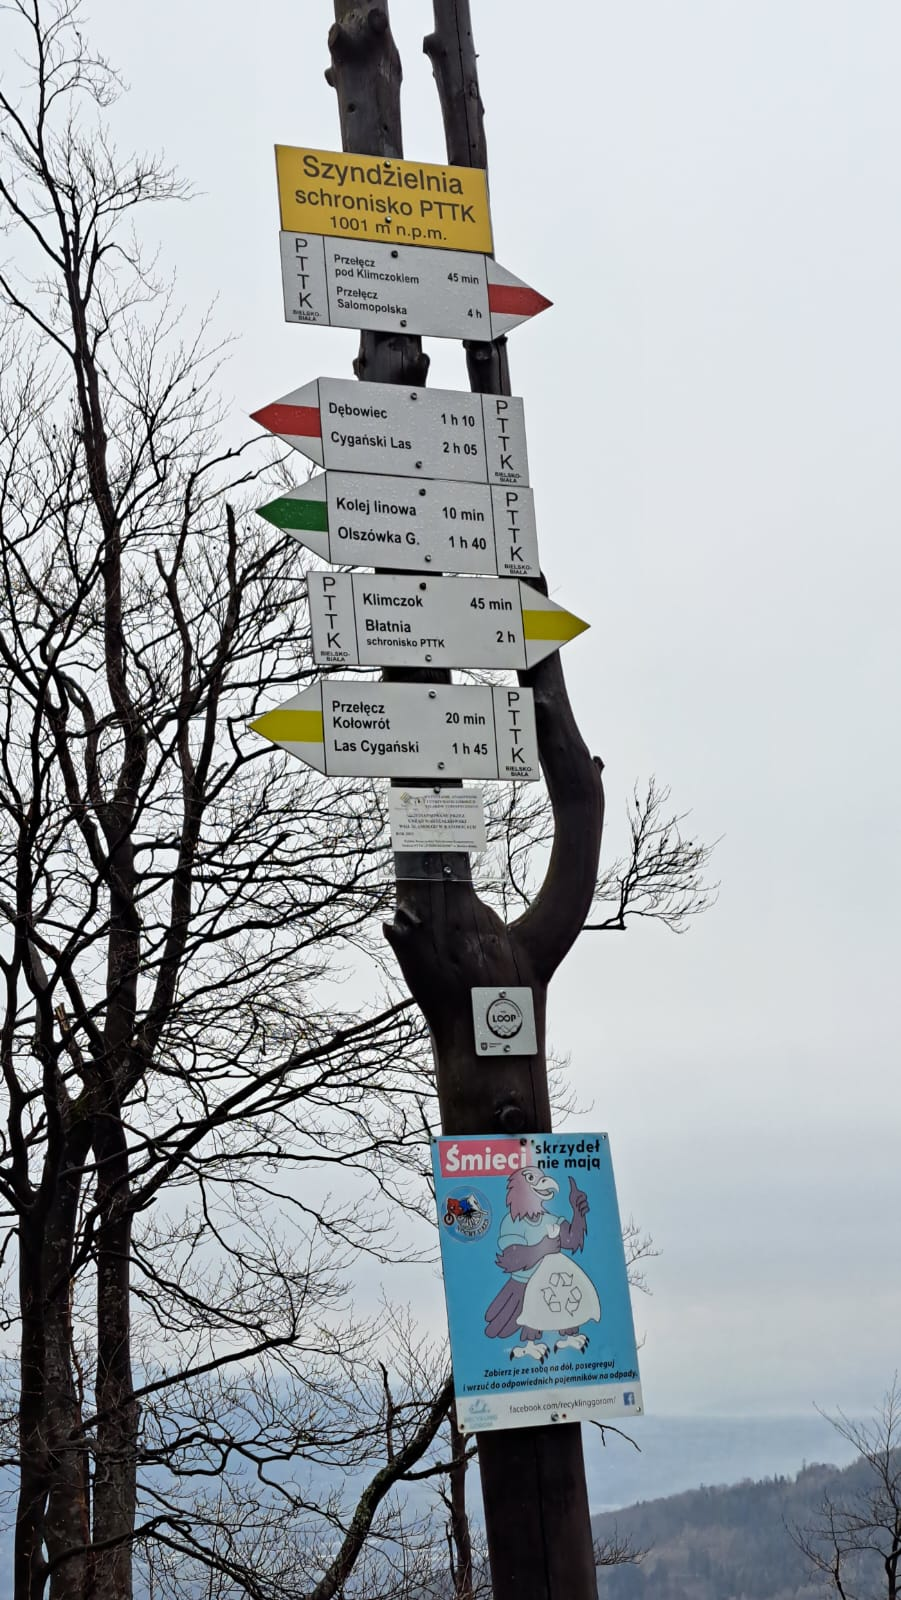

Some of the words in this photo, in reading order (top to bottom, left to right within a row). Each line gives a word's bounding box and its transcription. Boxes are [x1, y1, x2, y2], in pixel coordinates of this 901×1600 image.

[303, 155, 463, 195] Szyndzielnia
[295, 189, 413, 217] schronisko
[420, 200, 476, 223] PTTK
[330, 216, 368, 232] 1001
[376, 223, 390, 235] m
[396, 225, 447, 241] n.p.m.
[334, 254, 376, 268] Przełęcz
[295, 238, 313, 309] PTTK
[335, 268, 354, 278] pod
[357, 268, 419, 284] Klimczokiem
[447, 273, 459, 283] 45
[461, 274, 480, 285] min
[336, 286, 378, 300] Przełęcz
[337, 299, 407, 315] Salomopolska
[467, 309, 474, 318] 4
[475, 309, 482, 319] h
[329, 402, 388, 420] Dębowiec
[441, 413, 447, 425] 1
[451, 414, 458, 426] h
[462, 415, 475, 427] 10
[331, 431, 387, 449] Cygański
[391, 436, 412, 450] Las
[443, 441, 450, 454] 2
[453, 442, 461, 455] h
[463, 443, 478, 456] 05
[496, 400, 514, 470] PTTK
[336, 497, 370, 515] Kolej
[375, 501, 417, 517] linowa
[442, 507, 457, 521] 10
[461, 508, 485, 522] min
[338, 526, 402, 544] Olszówka
[406, 531, 421, 546] G.
[448, 536, 455, 548] 1
[459, 536, 468, 549] h
[471, 538, 487, 550] 40
[506, 492, 524, 562] PTTK
[322, 576, 342, 648] PTTK
[363, 593, 424, 608] Klimczok
[470, 597, 485, 610] 45
[489, 598, 513, 611] min
[365, 619, 411, 633] Błatnia
[496, 630, 504, 643] 2
[507, 631, 515, 644] h
[366, 637, 418, 648] schronisko
[420, 638, 446, 648] PTTK
[332, 701, 385, 716] Przełęcz
[333, 716, 391, 730] Kołowrót
[446, 712, 460, 725] 20
[463, 712, 486, 725] min
[508, 691, 526, 764] PTTK
[334, 739, 357, 752] Las
[361, 740, 420, 755] Cygański
[452, 743, 459, 755] 1
[462, 743, 470, 755] h
[473, 743, 489, 756] 45
[492, 1014, 516, 1023] LOOP
[446, 1144, 527, 1172] Śmieci
[536, 1139, 600, 1157] skrzydeł
[538, 1156, 559, 1170] nie
[565, 1155, 600, 1171] mają
[466, 1382, 489, 1392] wrzuć
[490, 1381, 500, 1390] do
[502, 1376, 554, 1389] odpowiednich
[554, 1373, 597, 1385] pojemników
[610, 1369, 638, 1379] odpady.
[484, 1368, 512, 1378] Zabierz
[513, 1367, 520, 1377] je
[521, 1367, 530, 1375] ze
[531, 1365, 549, 1374] sobą
[575, 1360, 615, 1371] posegreguj
